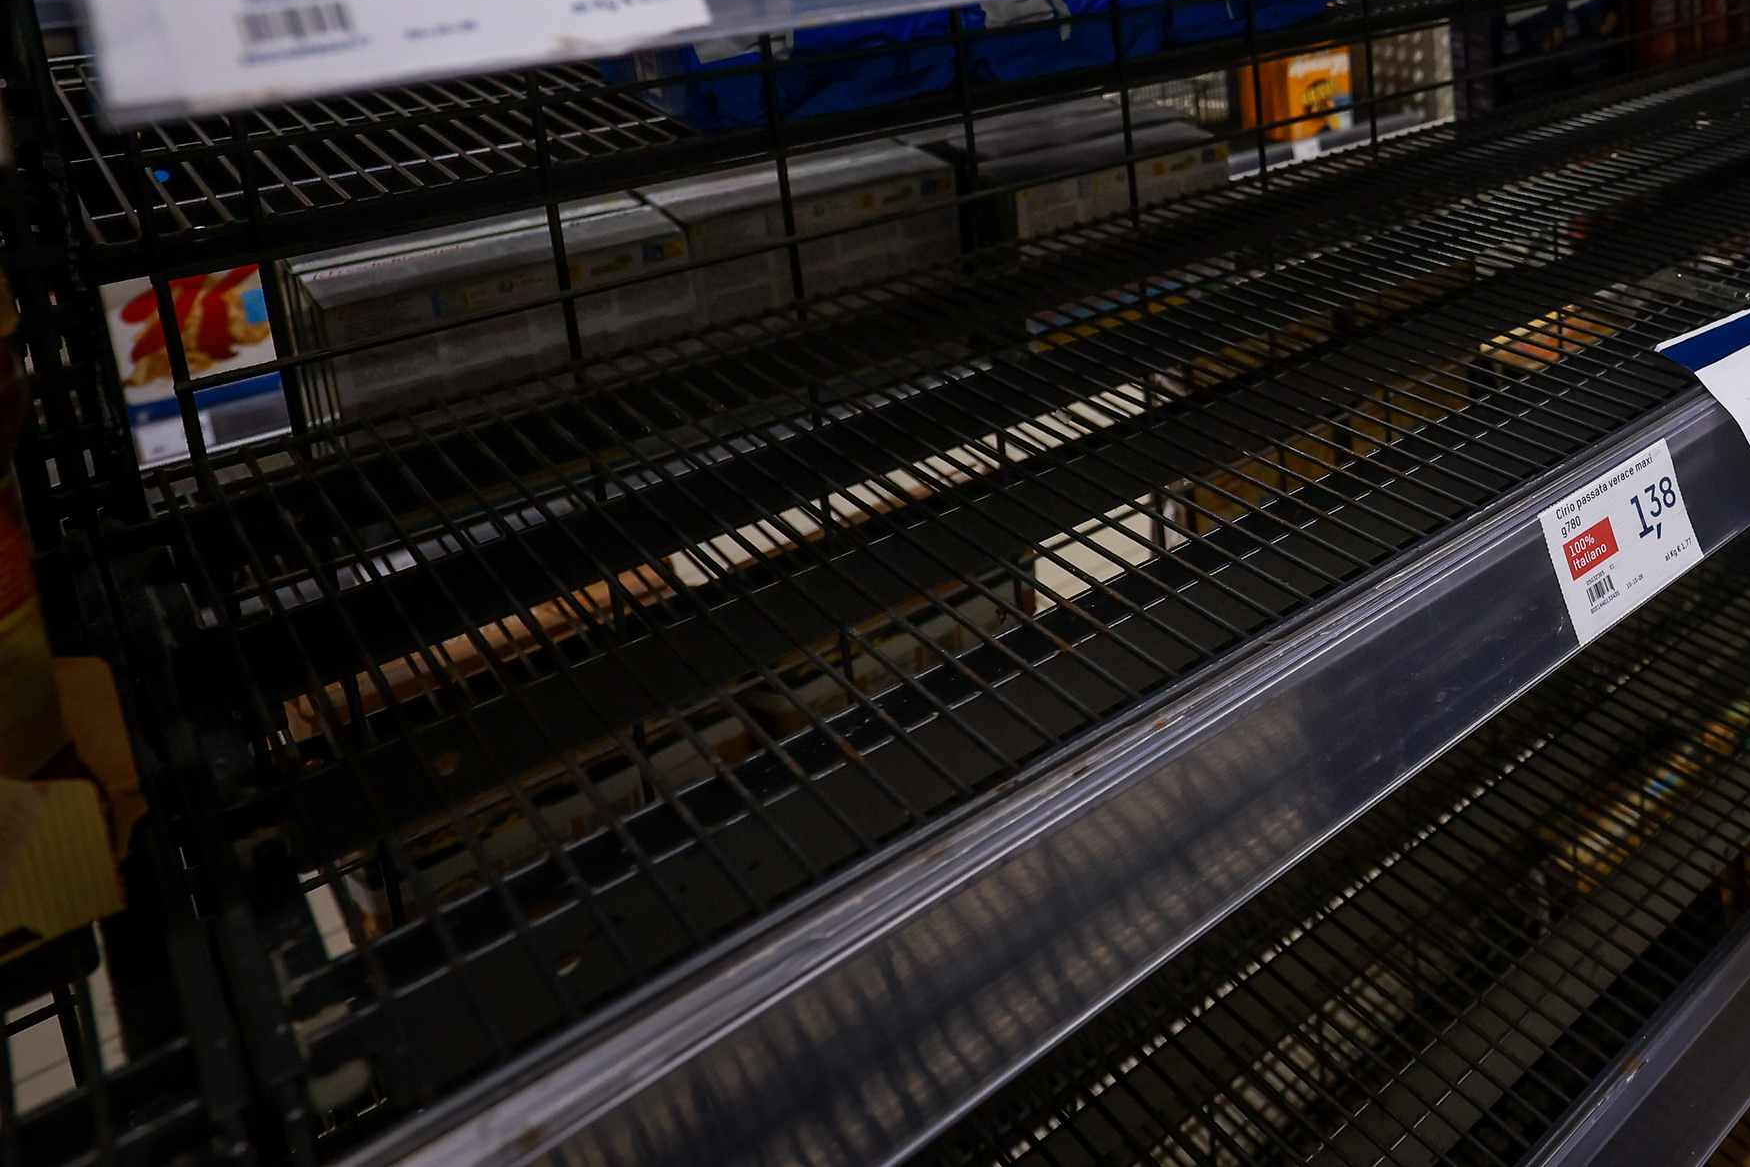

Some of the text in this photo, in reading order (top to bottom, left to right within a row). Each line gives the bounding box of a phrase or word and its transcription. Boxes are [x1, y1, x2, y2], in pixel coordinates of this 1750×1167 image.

[1555, 453, 1653, 520] Cirio passata verace maxi
[1630, 476, 1676, 540] 1,38
[1561, 515, 1581, 539] g780
[1569, 534, 1595, 557] 100%
[1573, 543, 1607, 571] Italiano
[1665, 552, 1671, 561] al
[1670, 549, 1678, 557] Kg
